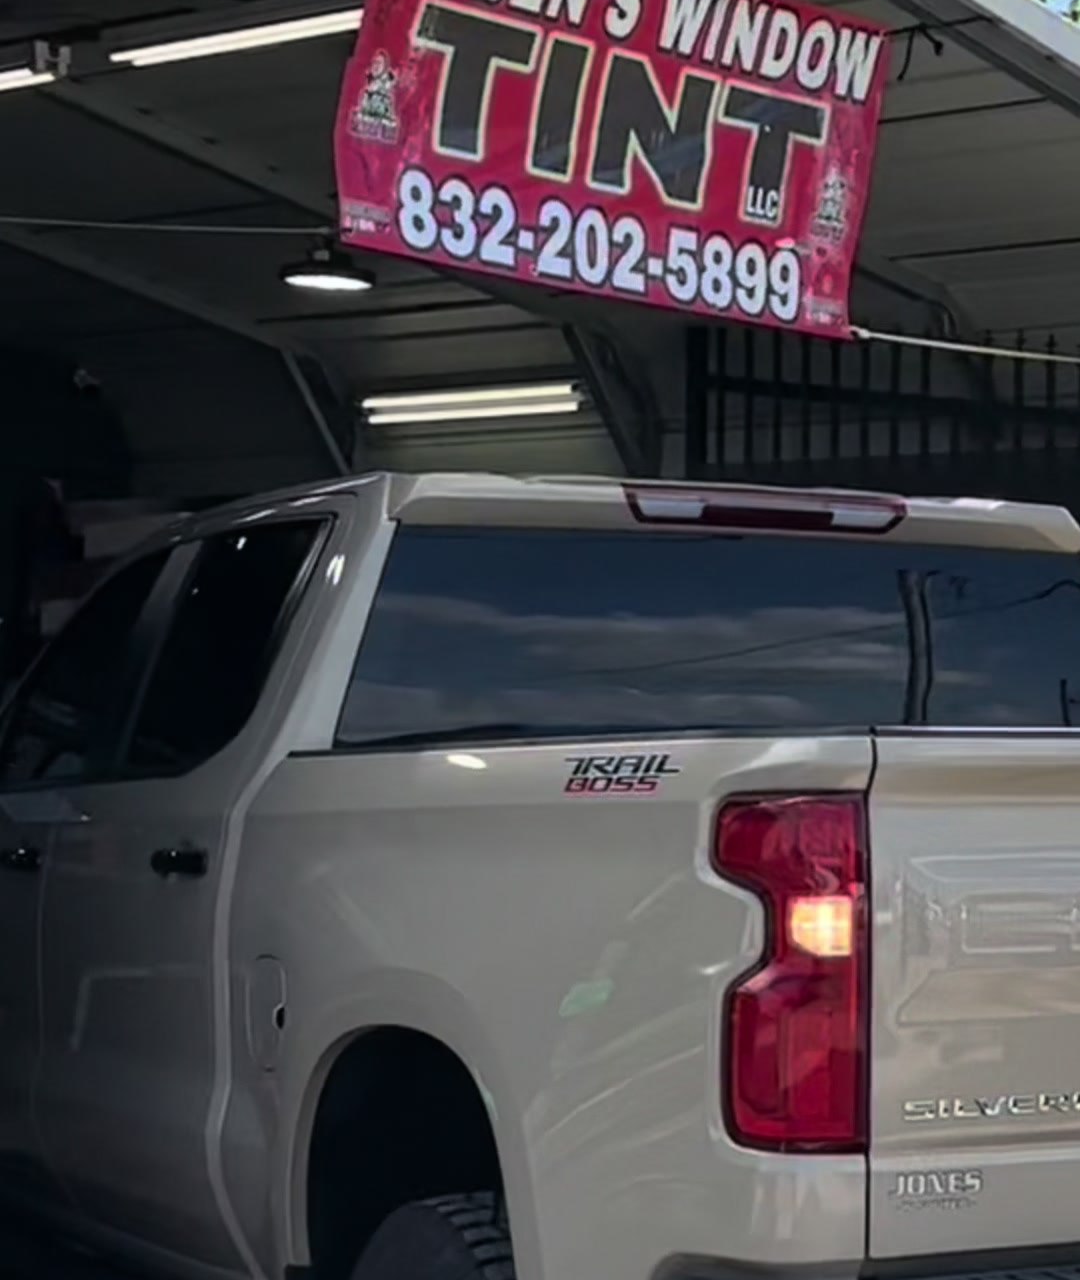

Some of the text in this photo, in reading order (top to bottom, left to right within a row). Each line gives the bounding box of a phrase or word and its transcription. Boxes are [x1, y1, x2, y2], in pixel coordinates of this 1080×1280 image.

[745, 184, 779, 218] LLC
[397, 170, 801, 322] 832-202-5899
[564, 753, 680, 776] TRAIL
[563, 775, 660, 793] BOSS
[889, 1168, 983, 1198] JONES
